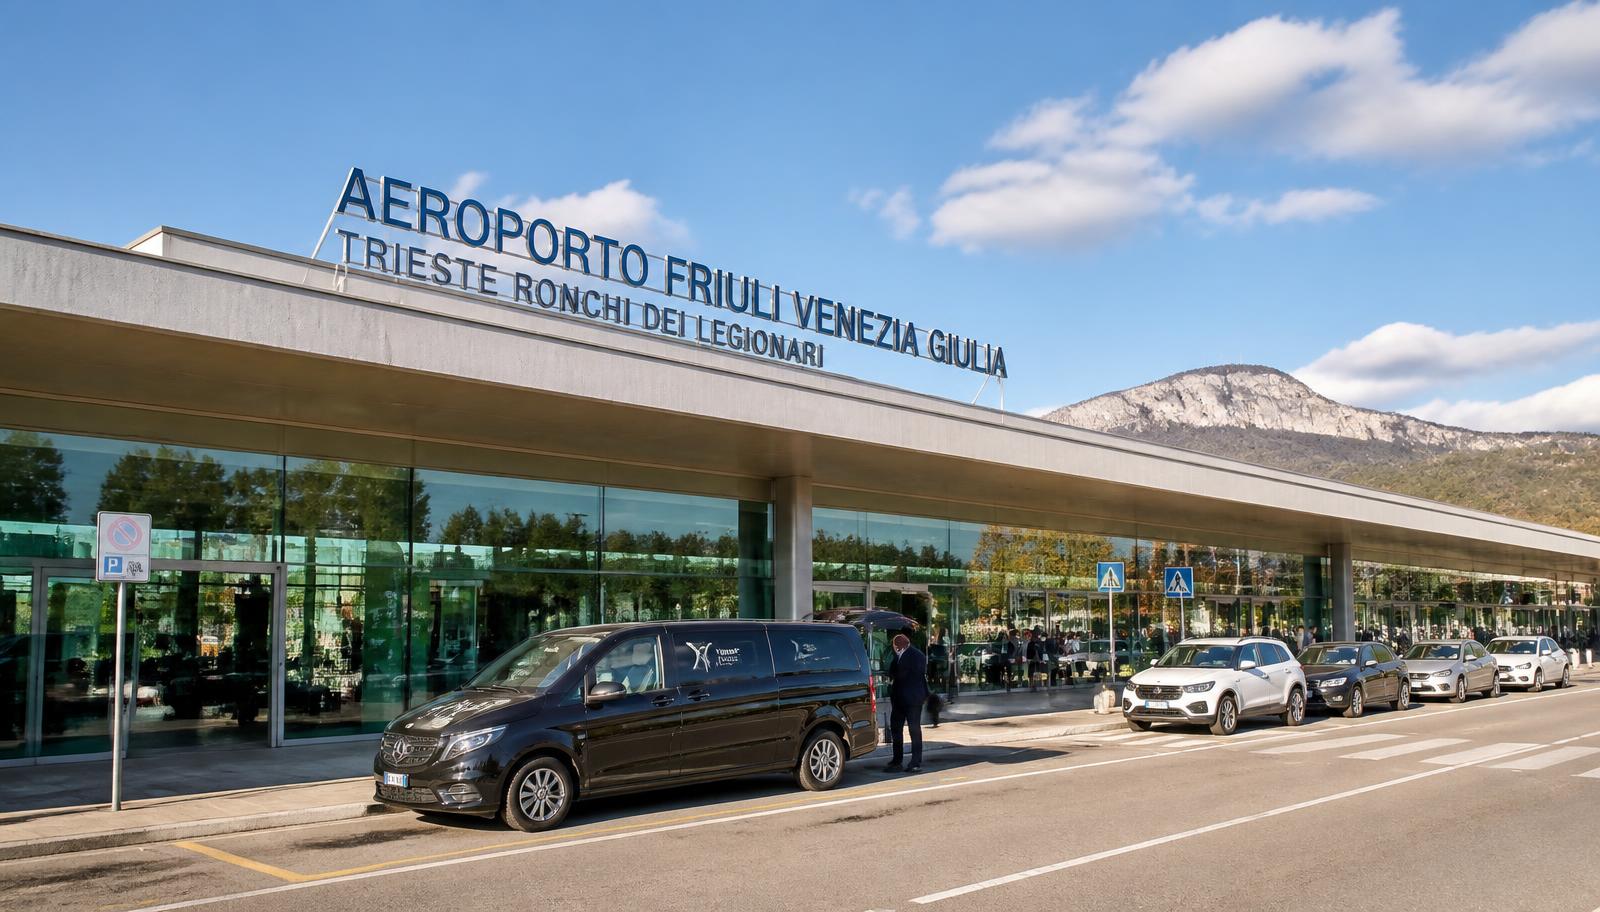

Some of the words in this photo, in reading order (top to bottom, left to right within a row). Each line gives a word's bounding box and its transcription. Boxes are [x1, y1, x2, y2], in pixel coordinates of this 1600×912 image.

[335, 228, 498, 296] TRIESTE
[514, 272, 630, 326] RONCHI
[642, 303, 685, 337] DEI
[695, 315, 823, 368] LEGIONARI
[337, 167, 649, 288] AEROPORTO
[664, 255, 780, 322] FRIULI
[791, 290, 919, 357] VENEZIA
[927, 328, 1008, 379] GIULIA
[108, 558, 119, 572] P
